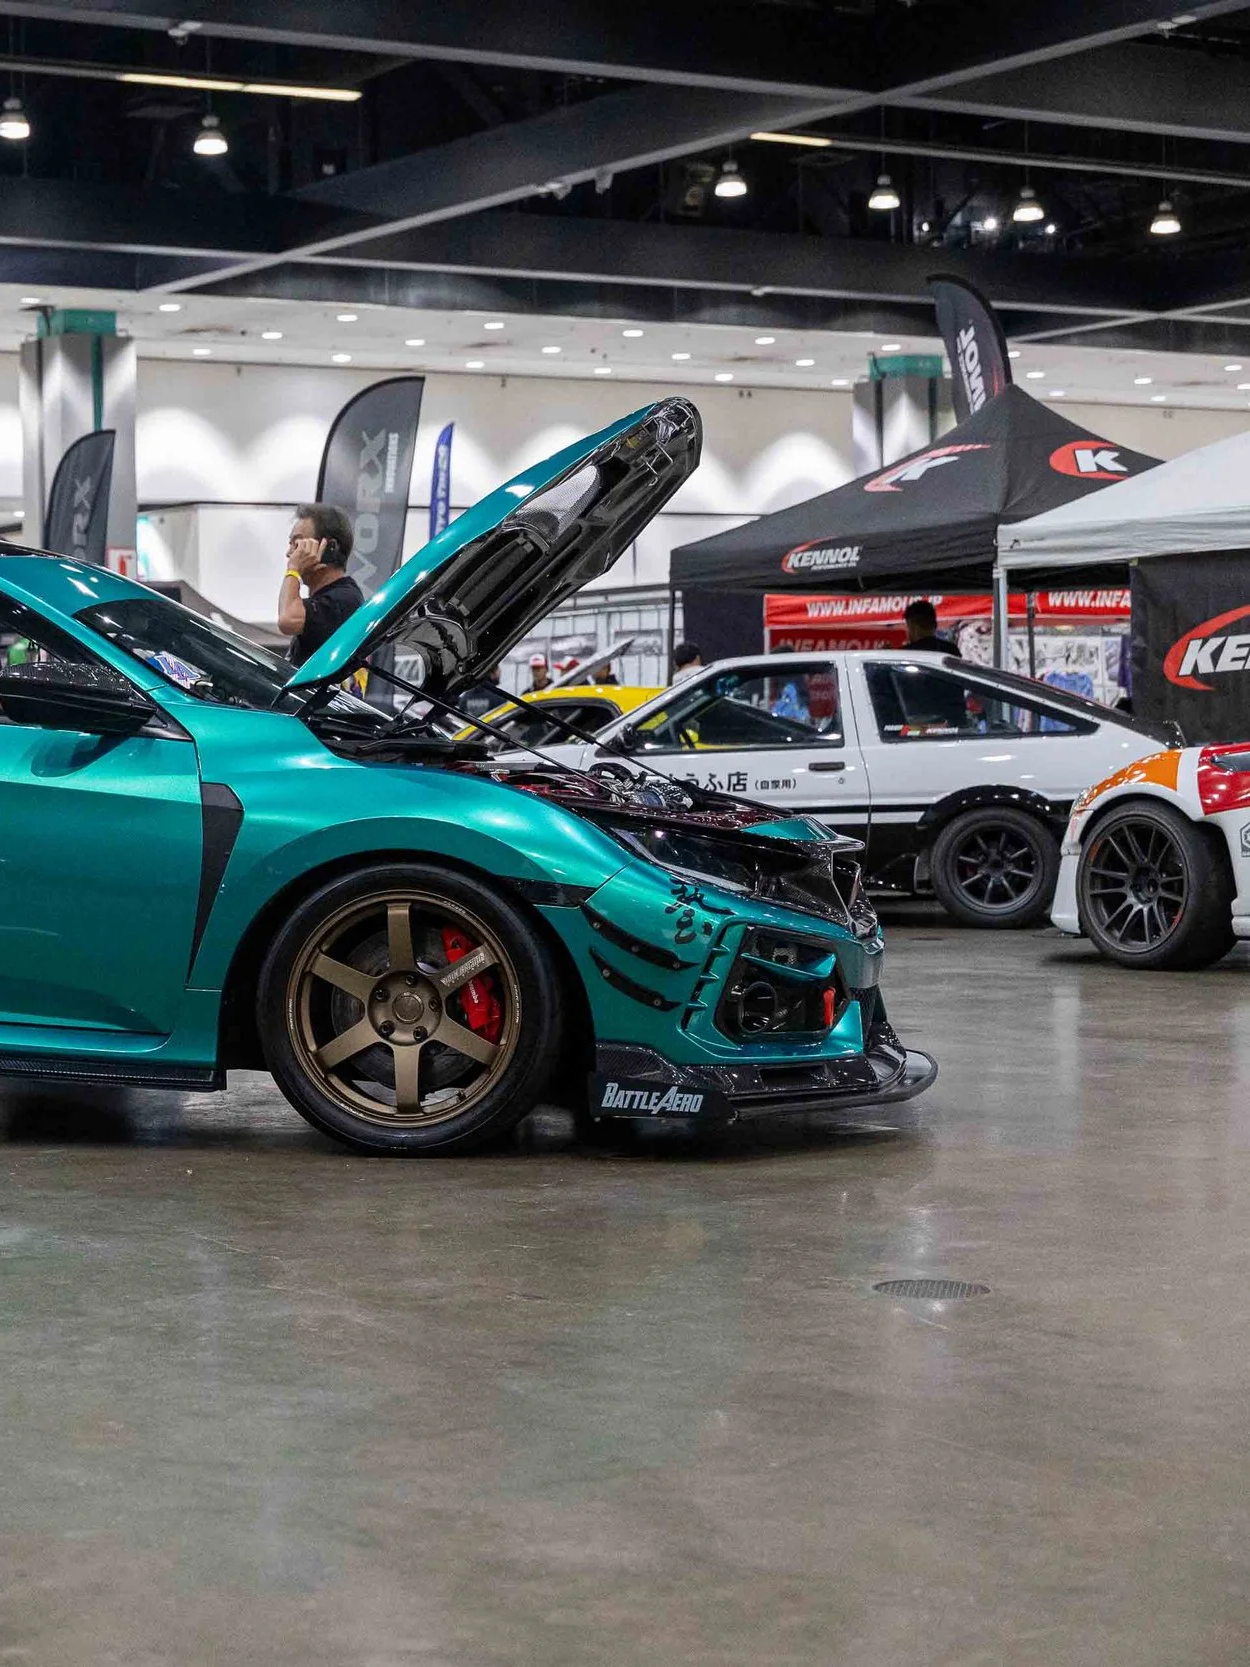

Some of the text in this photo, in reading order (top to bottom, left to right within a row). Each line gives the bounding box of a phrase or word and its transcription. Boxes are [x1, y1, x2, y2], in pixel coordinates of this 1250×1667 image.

[1074, 448, 1130, 474] K
[787, 545, 861, 569] KENNOL
[1178, 634, 1250, 676] KE
